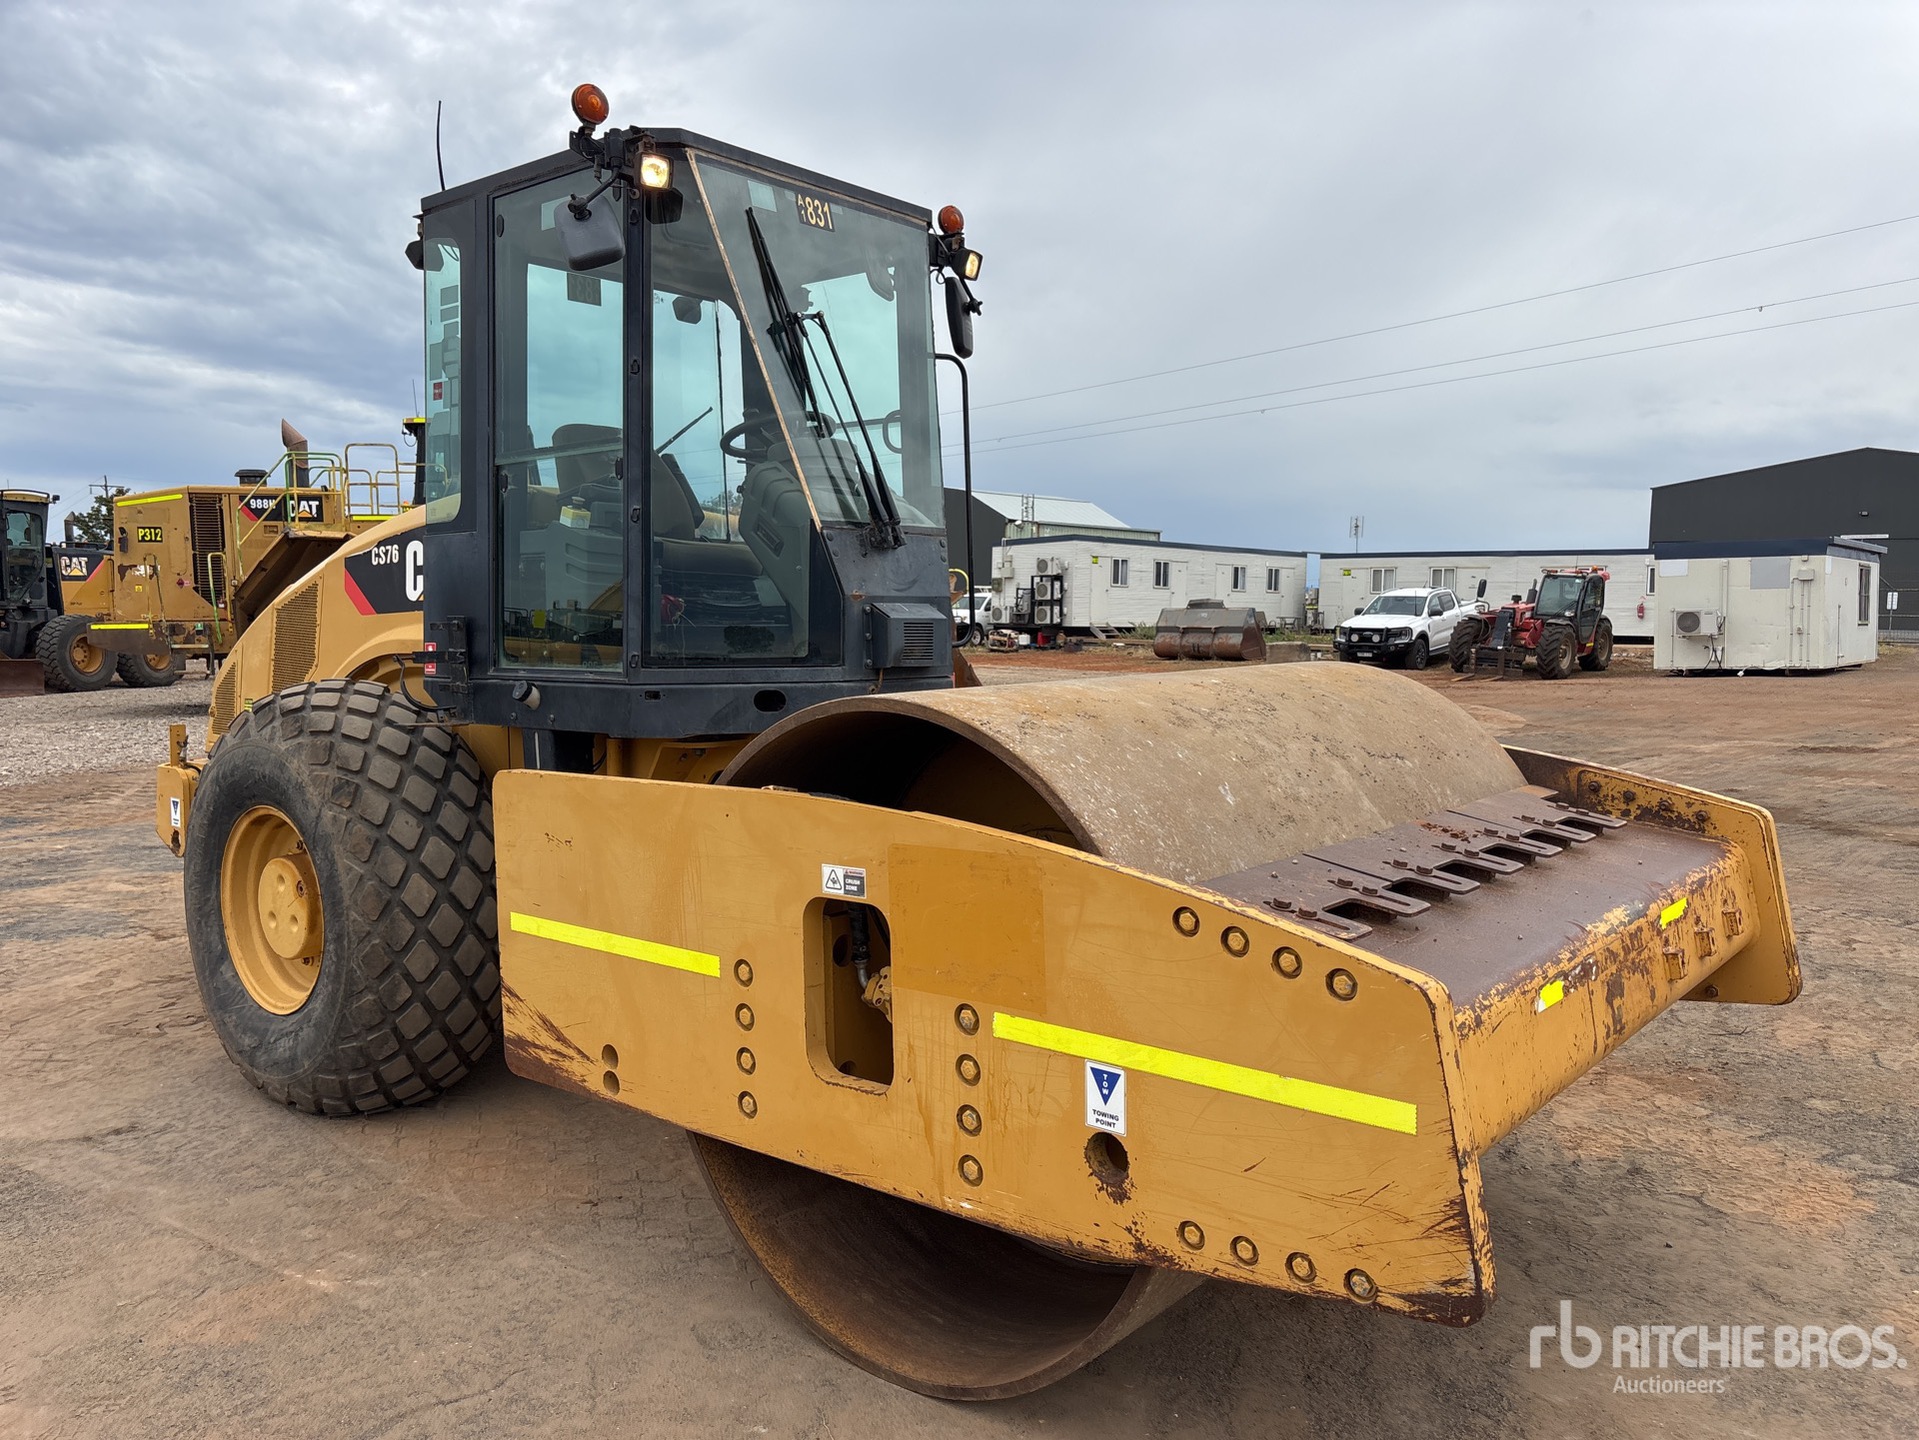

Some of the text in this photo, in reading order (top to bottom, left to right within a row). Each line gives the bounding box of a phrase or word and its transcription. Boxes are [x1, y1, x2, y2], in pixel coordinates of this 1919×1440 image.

[805, 196, 833, 230] 831
[138, 528, 162, 541] P312
[371, 544, 399, 566] CS76
[60, 556, 88, 576] CAT
[1092, 1108, 1119, 1121] TOWING
[1095, 1118, 1116, 1128] POINT
